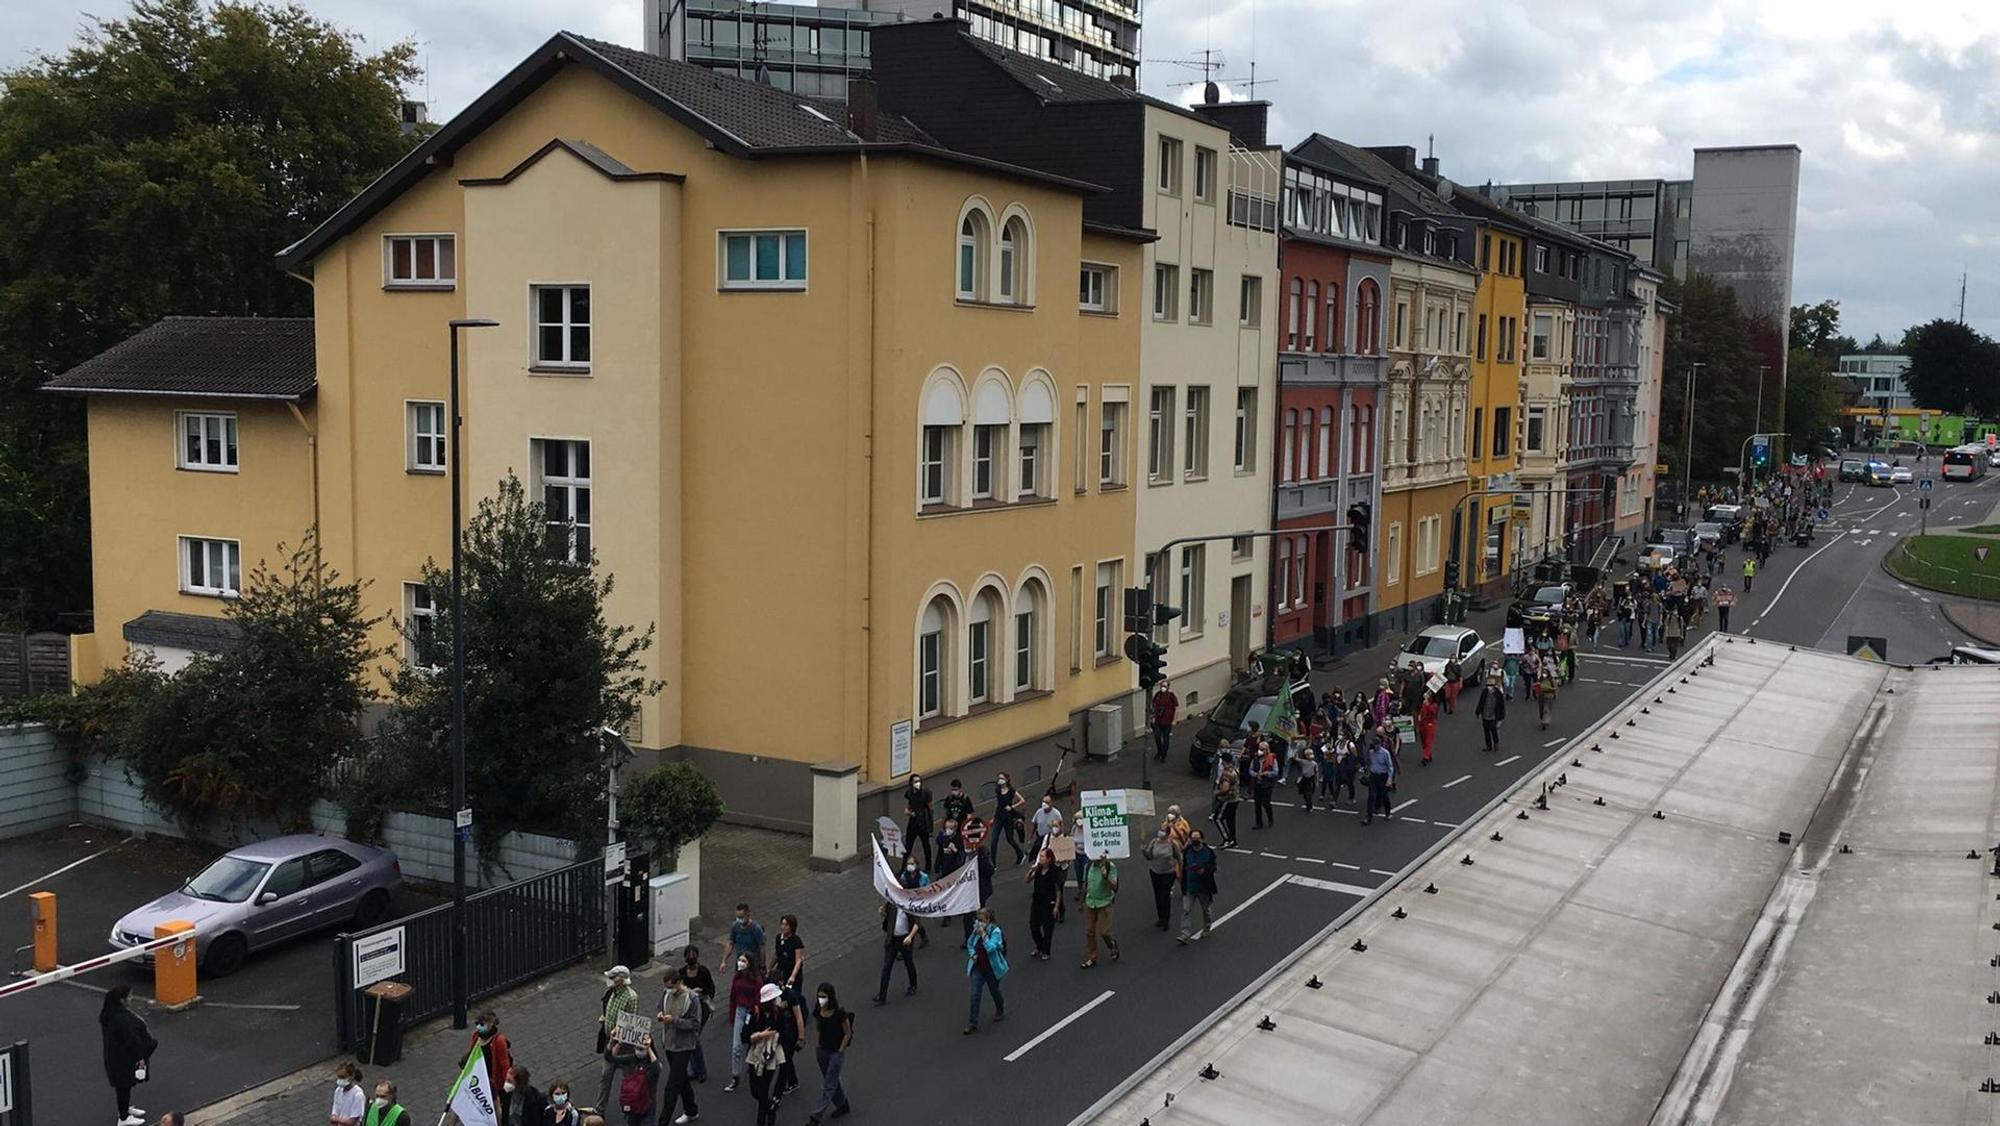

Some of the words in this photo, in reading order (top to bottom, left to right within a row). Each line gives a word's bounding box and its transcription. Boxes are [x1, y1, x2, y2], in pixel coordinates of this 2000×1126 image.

[1085, 807, 1115, 818] Klima-
[1092, 815, 1124, 827] Schutz
[1100, 830, 1121, 838] Schutz
[471, 1087, 494, 1115] BUND
